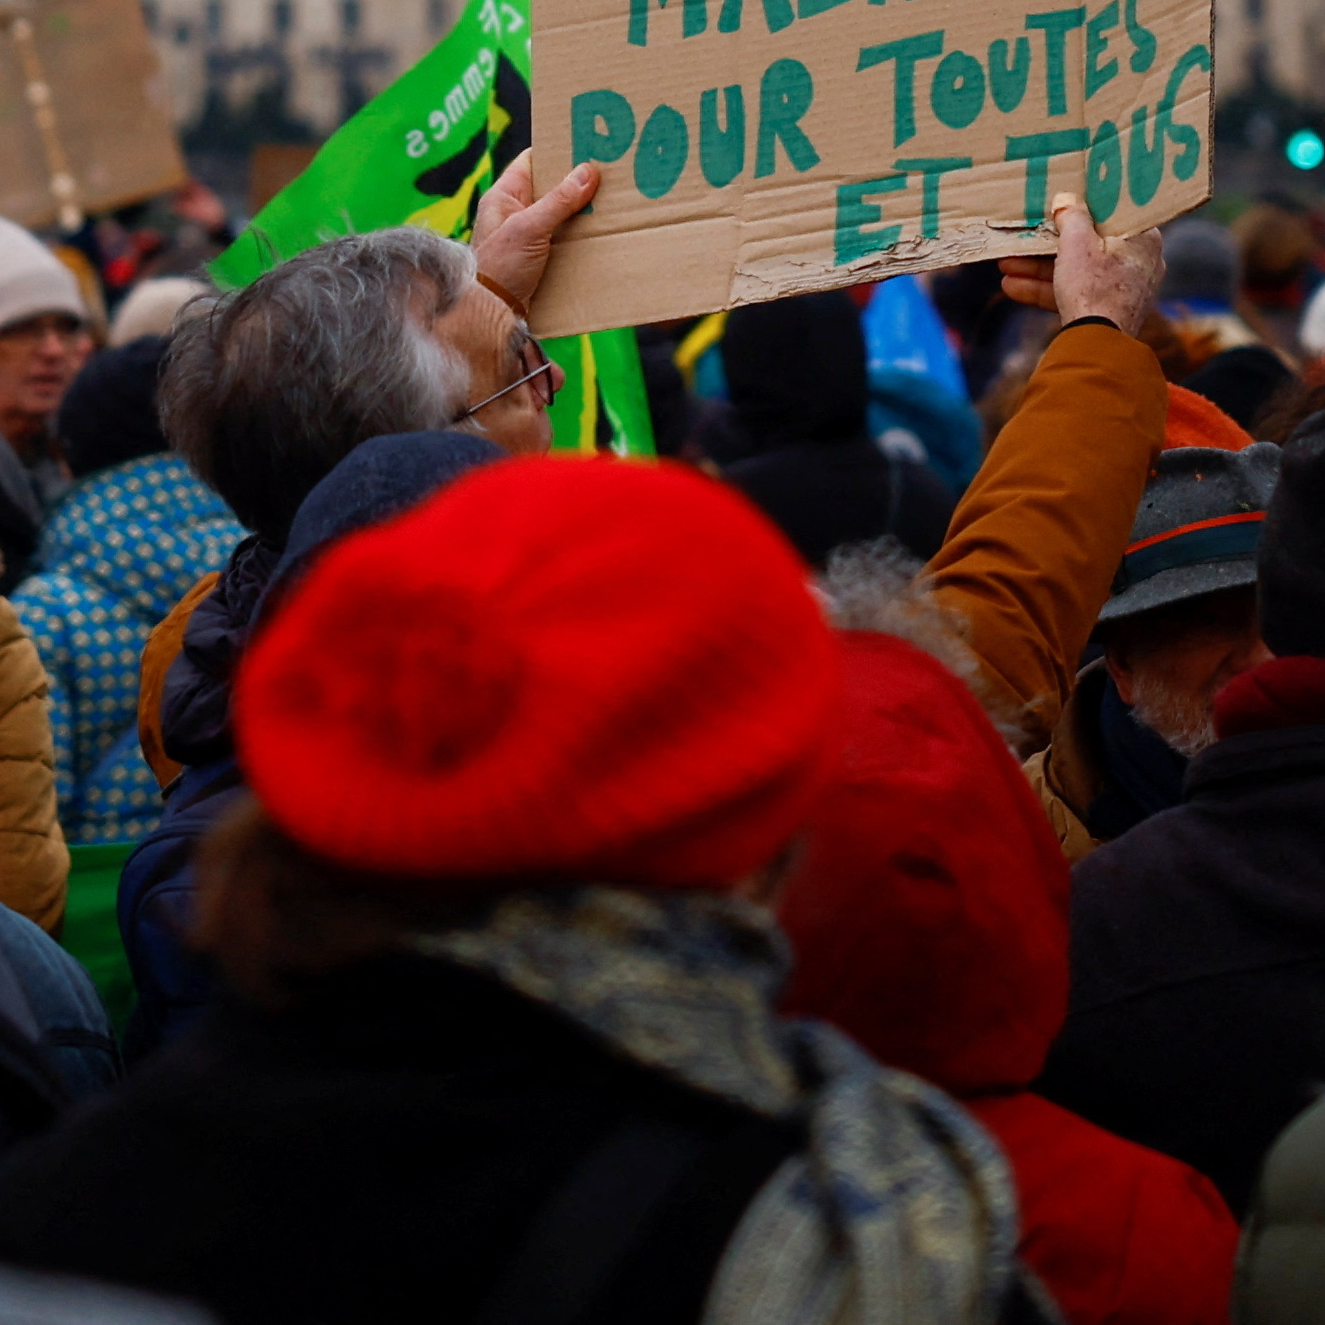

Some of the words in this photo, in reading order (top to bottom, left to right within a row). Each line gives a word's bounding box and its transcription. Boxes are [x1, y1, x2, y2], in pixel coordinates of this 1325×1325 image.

[571, 58, 821, 205] POUR
[834, 157, 972, 267] ET
[1005, 44, 1213, 238] TOUS
